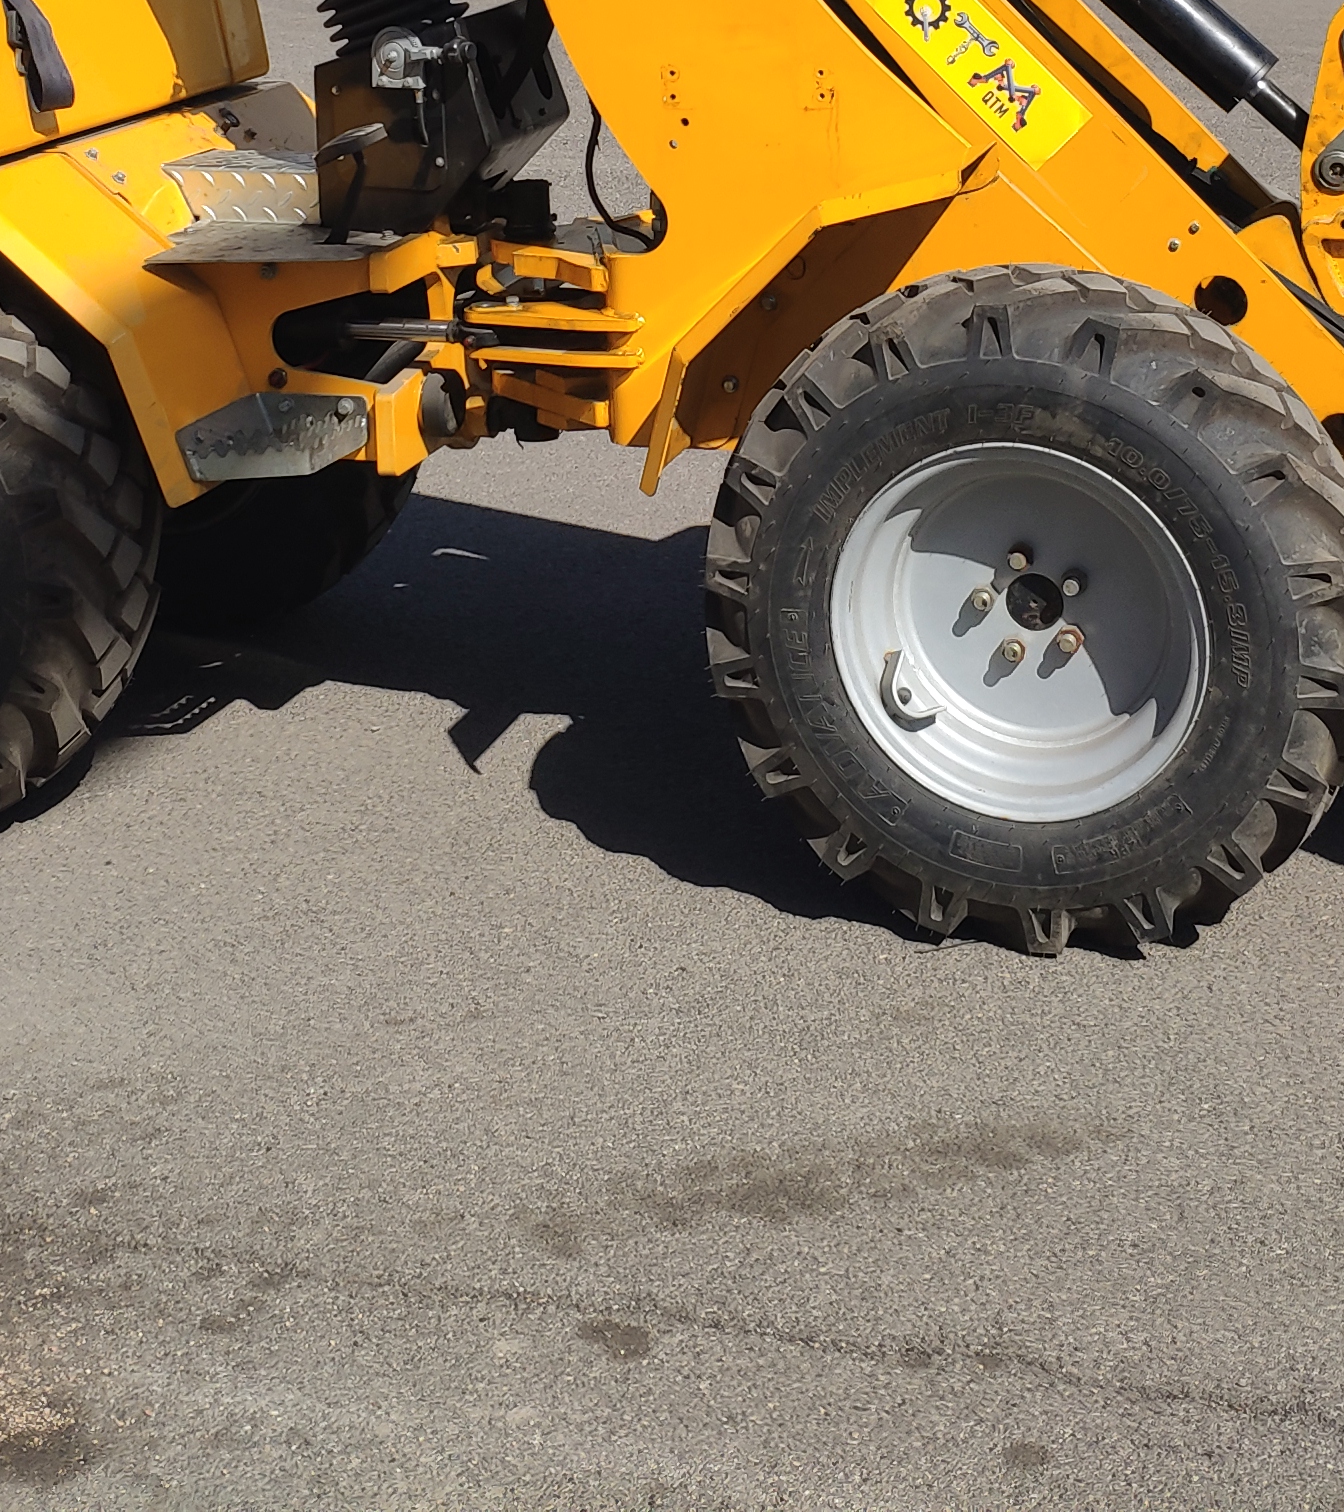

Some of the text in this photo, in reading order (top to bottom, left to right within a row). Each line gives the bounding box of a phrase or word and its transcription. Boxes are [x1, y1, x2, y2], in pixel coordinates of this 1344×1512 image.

[981, 90, 1010, 119] QTM
[812, 403, 1034, 524] IMPLEMENT I-3F
